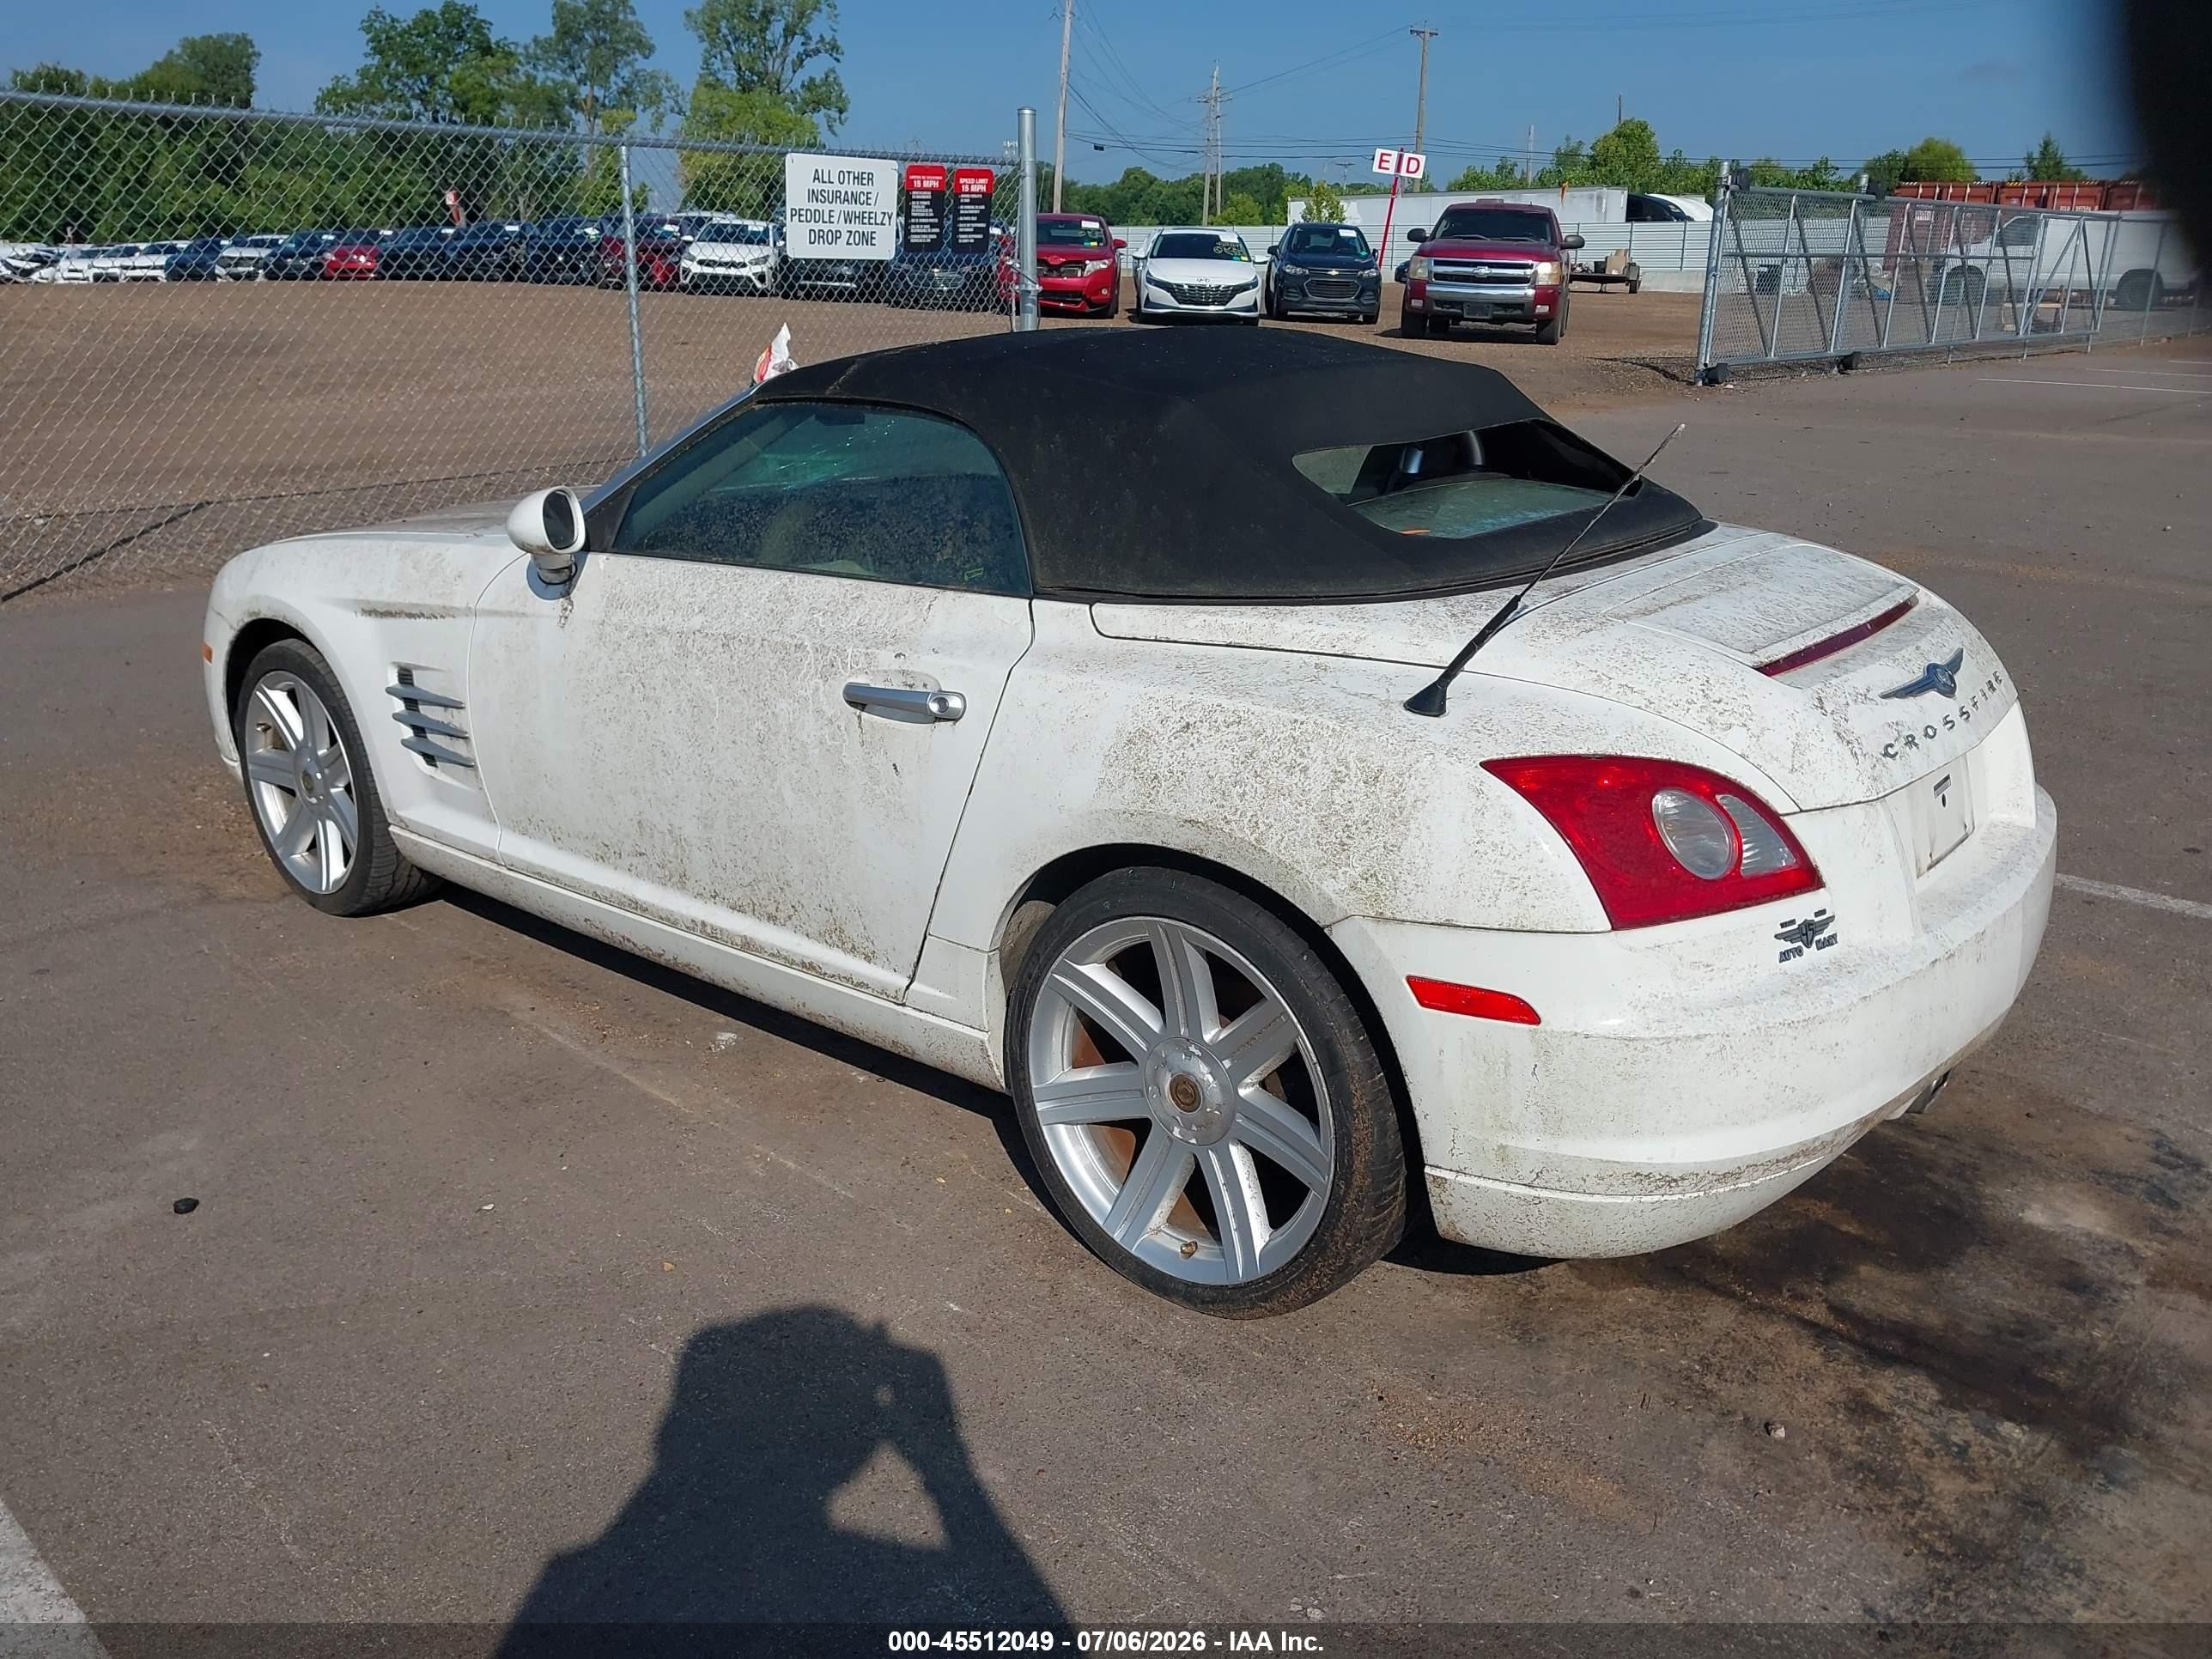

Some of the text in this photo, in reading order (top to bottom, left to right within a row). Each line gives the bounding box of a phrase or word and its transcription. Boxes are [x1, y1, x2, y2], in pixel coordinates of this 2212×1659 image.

[812, 168, 874, 186] ALL OTHER
[922, 179, 939, 188] MPH
[809, 228, 877, 246] DROP ZONE
[1883, 671, 2002, 758] CROSSFIRE
[1778, 945, 1804, 963] AUTO
